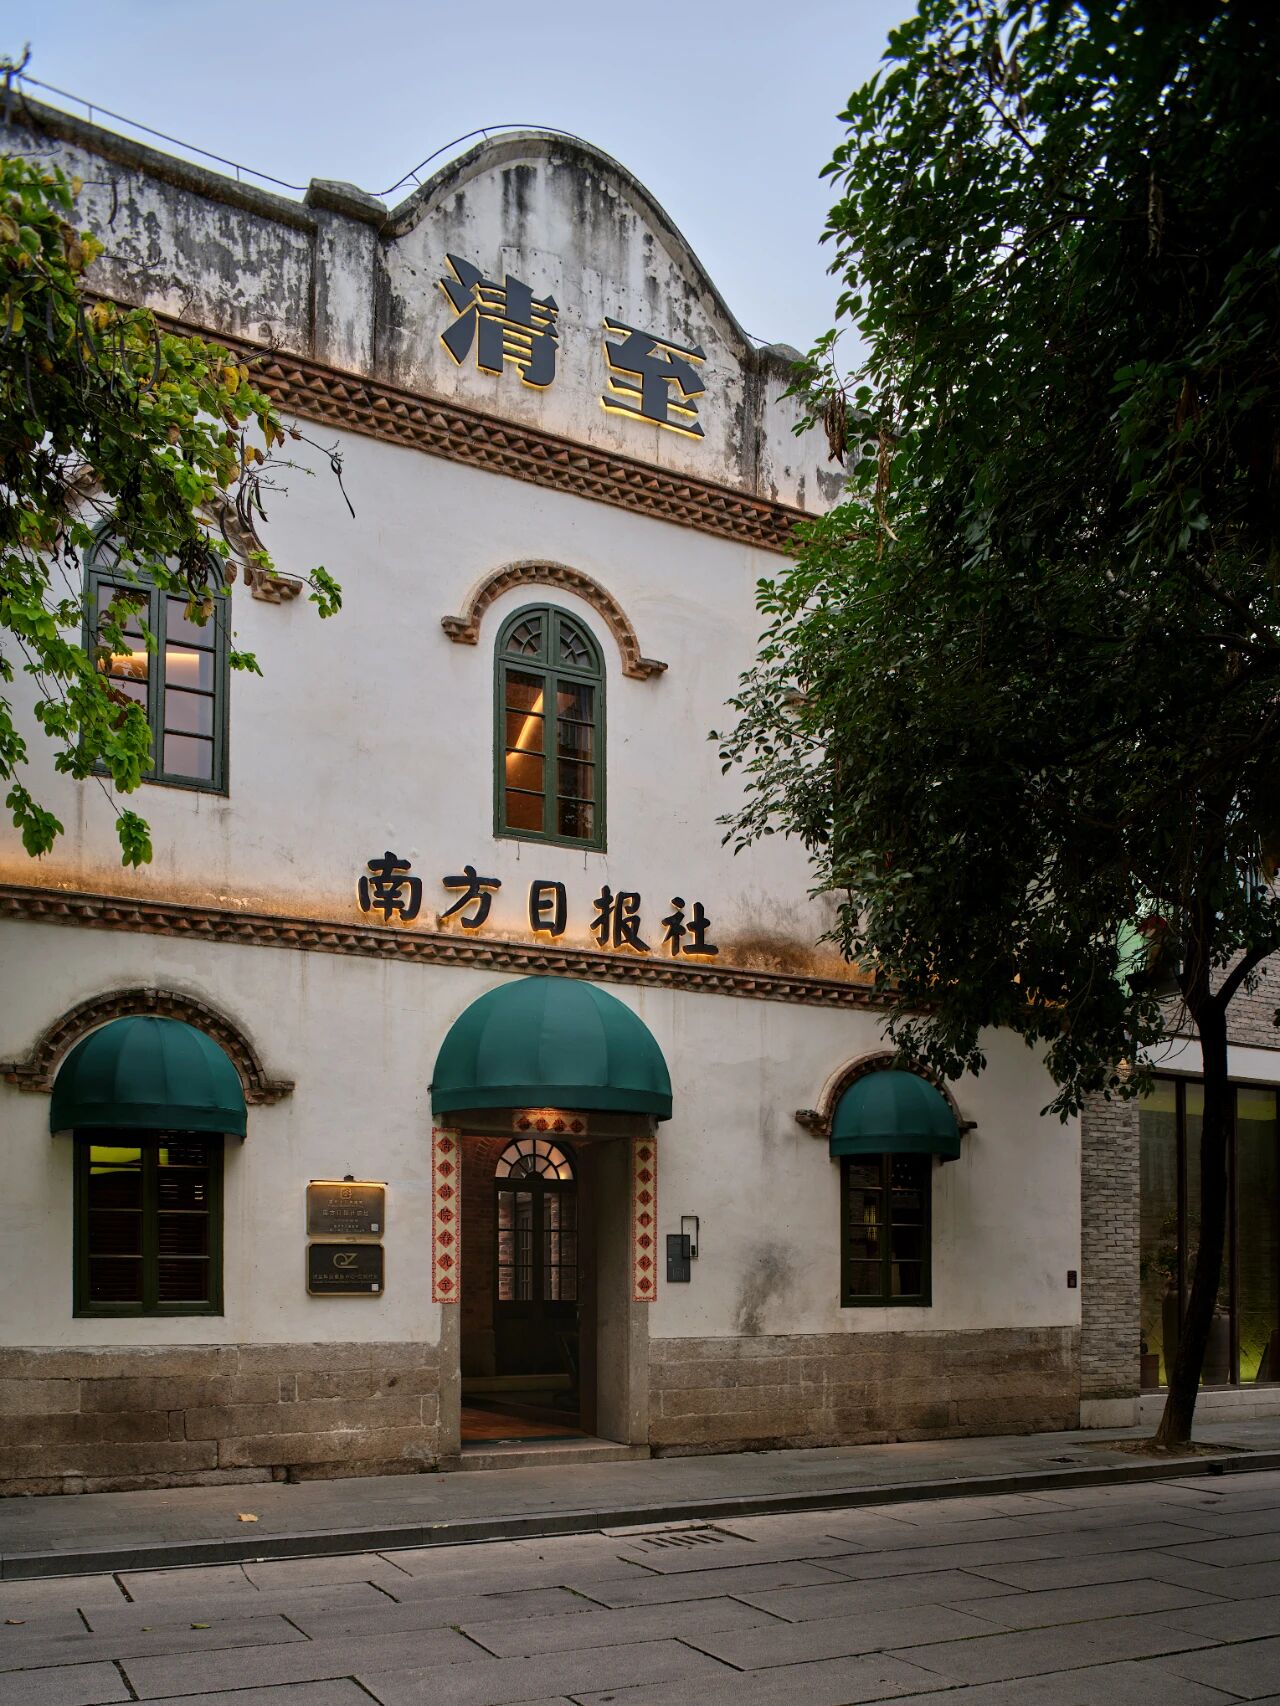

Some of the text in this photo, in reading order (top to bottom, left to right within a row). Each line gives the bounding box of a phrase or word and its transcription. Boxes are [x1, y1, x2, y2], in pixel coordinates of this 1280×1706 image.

[438, 252, 707, 440] 清至
[357, 850, 720, 957] 南方日报社
